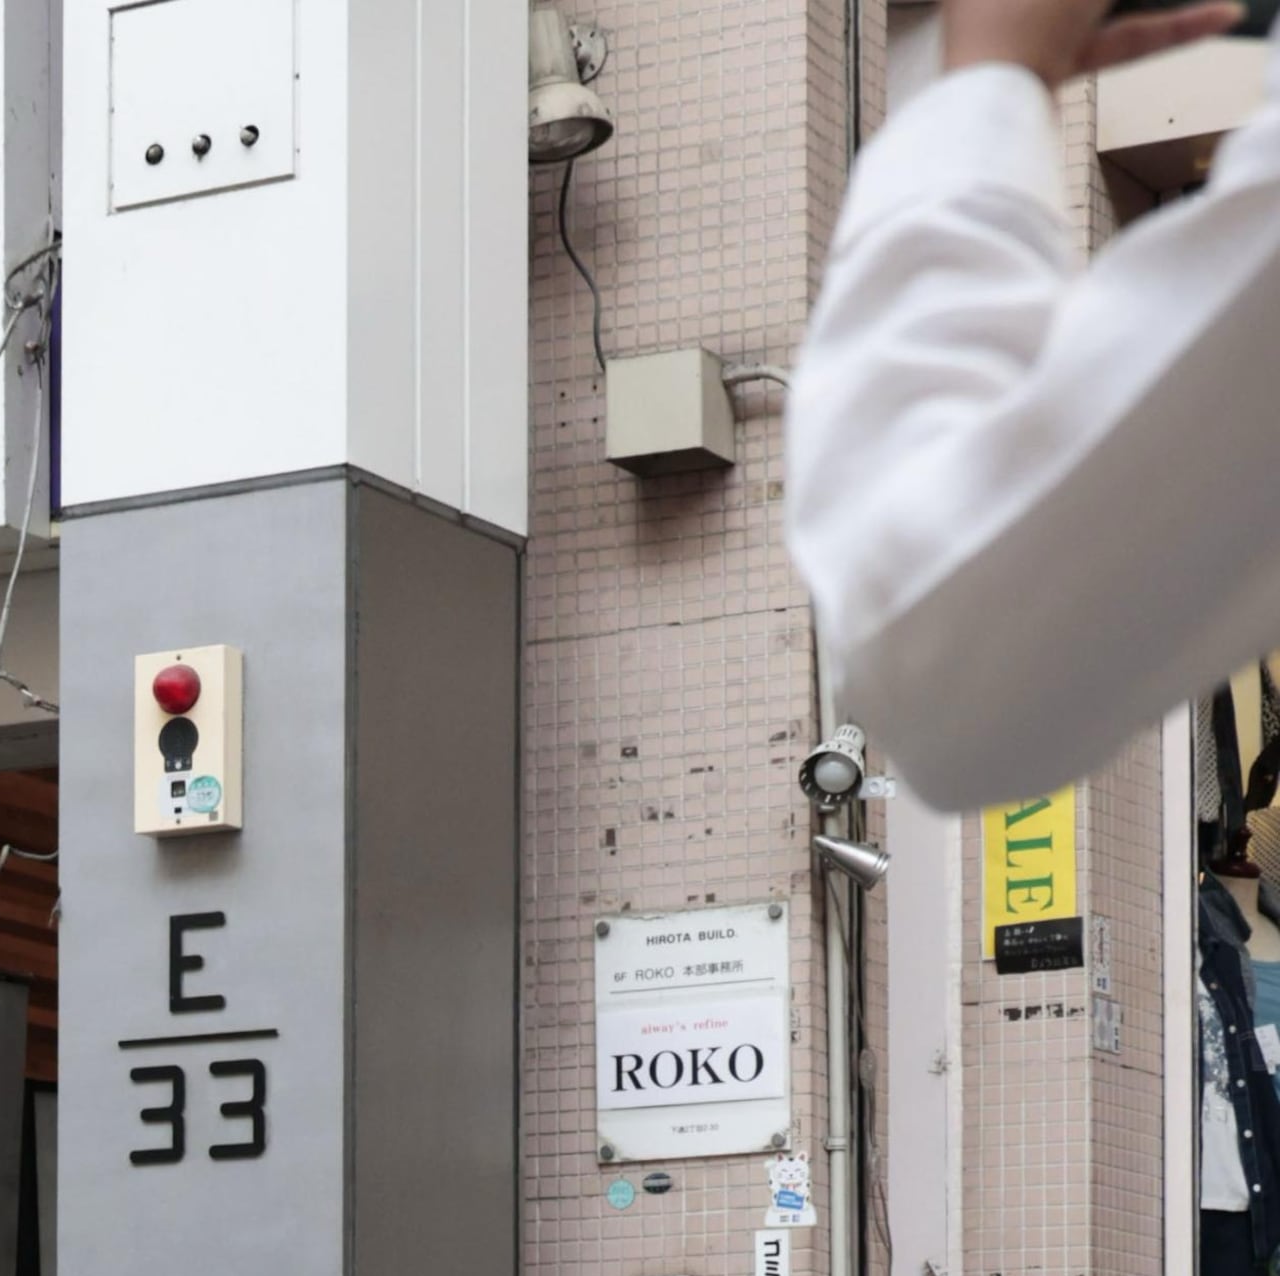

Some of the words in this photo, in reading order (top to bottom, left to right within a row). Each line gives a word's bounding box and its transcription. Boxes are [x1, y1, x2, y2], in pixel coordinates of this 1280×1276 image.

[645, 931, 692, 947] HIROTA
[169, 910, 227, 1015] E
[613, 971, 628, 983] 6F
[635, 966, 675, 982] ROKO
[682, 960, 744, 978] 本部事務所
[693, 1018, 729, 1032] refine
[611, 1043, 764, 1092] ROKO
[129, 1058, 267, 1166] 33
